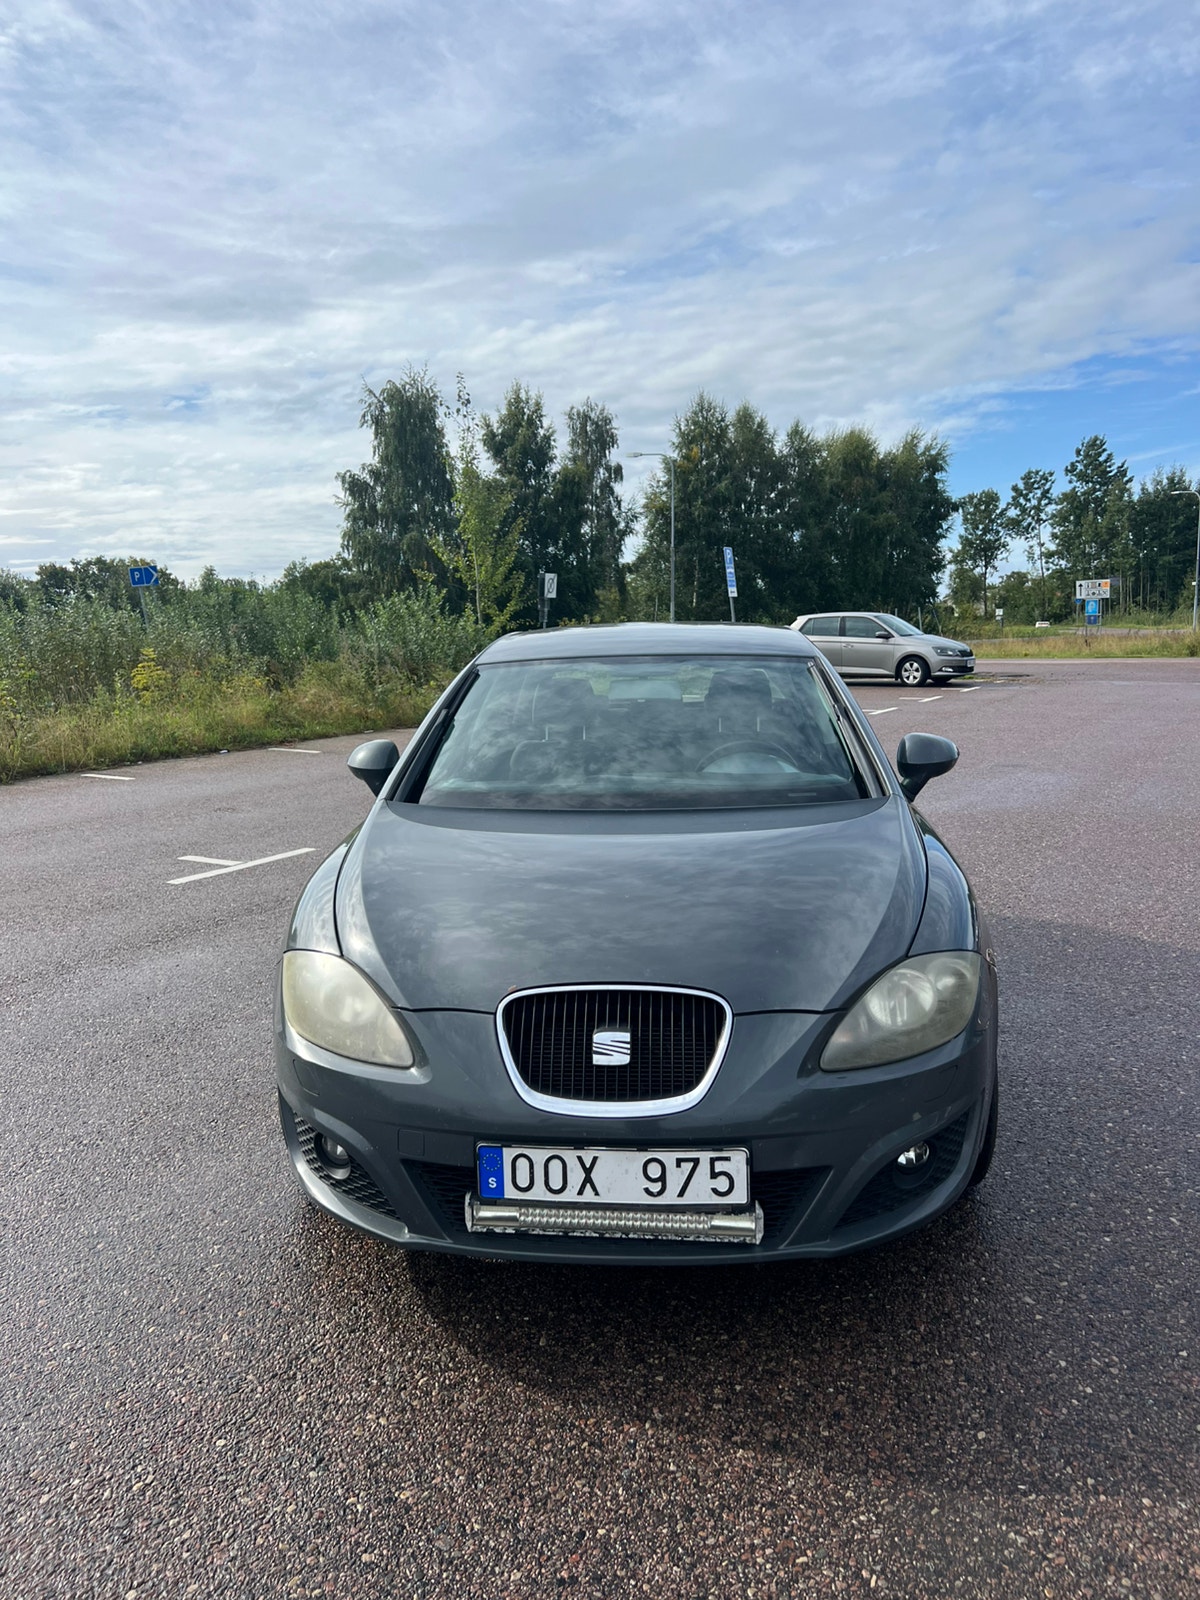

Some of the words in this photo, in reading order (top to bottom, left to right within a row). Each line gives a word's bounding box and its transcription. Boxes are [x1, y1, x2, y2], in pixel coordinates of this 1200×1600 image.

[726, 549, 731, 564] P
[134, 572, 140, 582] P
[510, 1152, 600, 1196] OOX
[642, 1155, 736, 1198] 975
[488, 1177, 497, 1188] S
